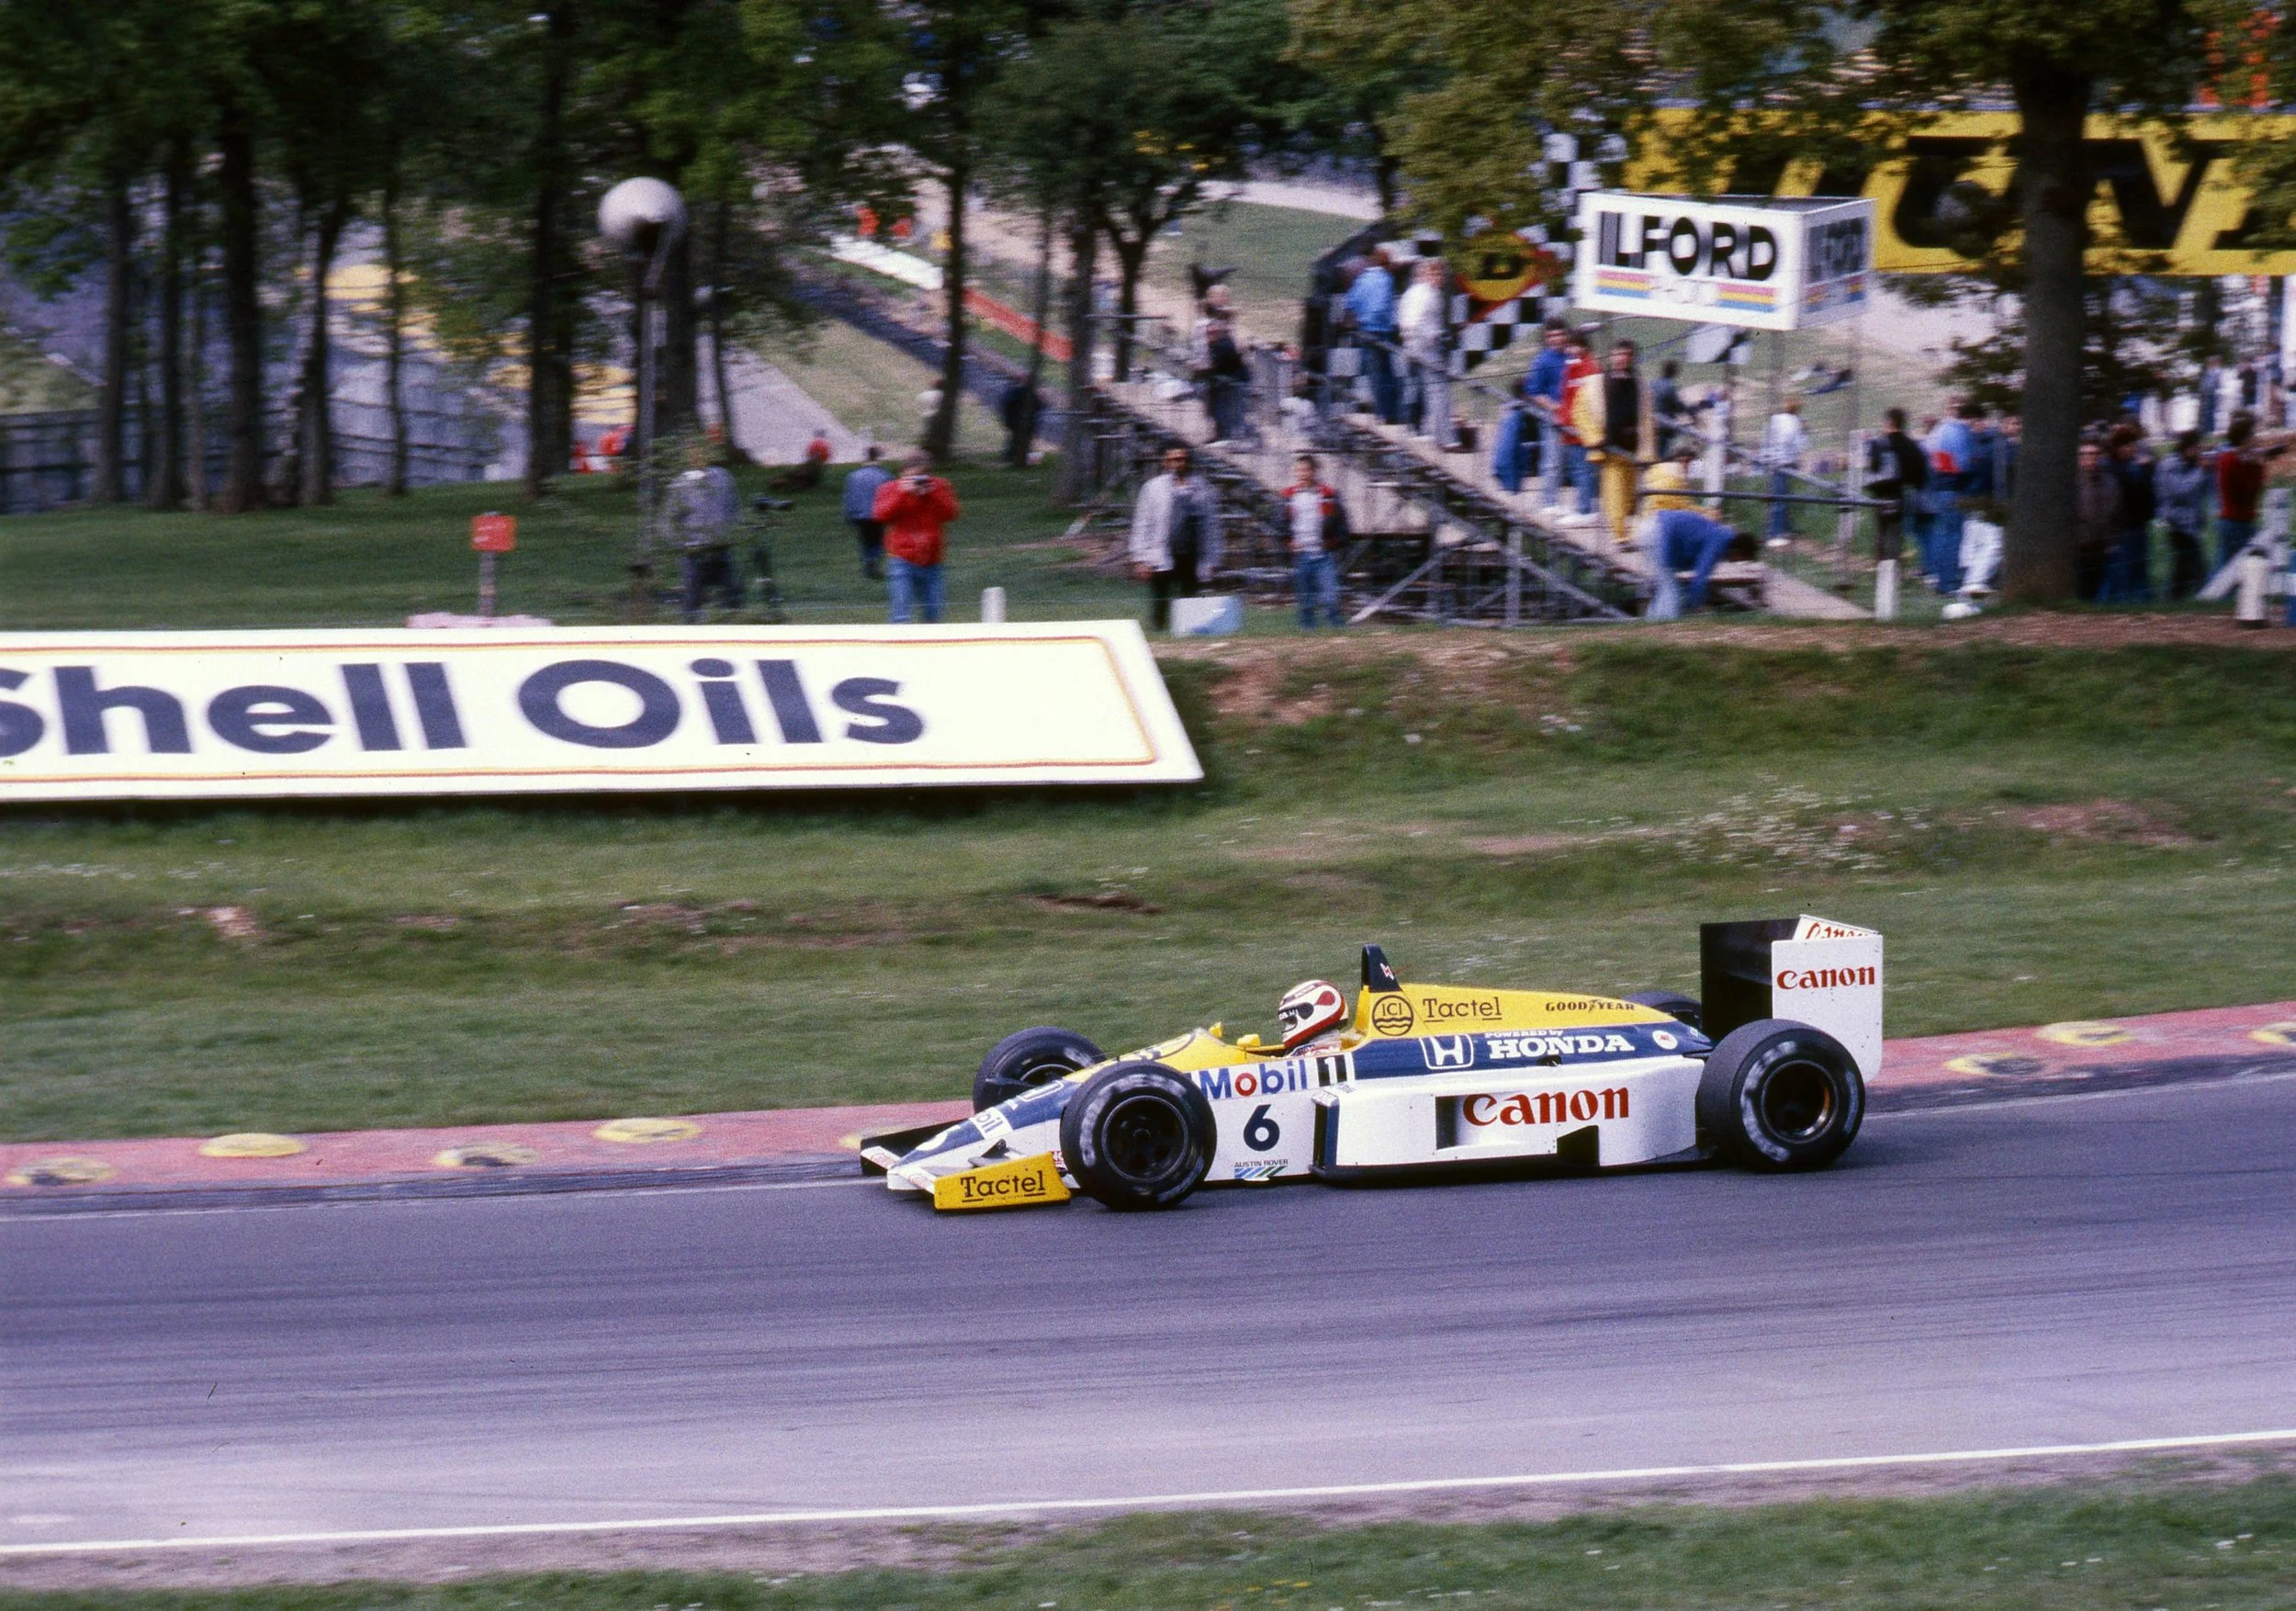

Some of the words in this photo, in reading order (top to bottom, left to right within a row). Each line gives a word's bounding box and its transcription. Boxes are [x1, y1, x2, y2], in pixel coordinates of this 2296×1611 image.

[1599, 211, 1776, 281] ILFORD
[518, 658, 925, 749] Oils
[1776, 966, 1875, 989] Canon
[1382, 1003, 1402, 1016] ICI
[1424, 997, 1503, 1018] Tactel
[1487, 1034, 1635, 1059] HONDA
[1199, 1059, 1308, 1099] Mobil
[1463, 1087, 1629, 1126] Canon
[1244, 1104, 1280, 1152] 6
[960, 1171, 1046, 1198] Tactel
